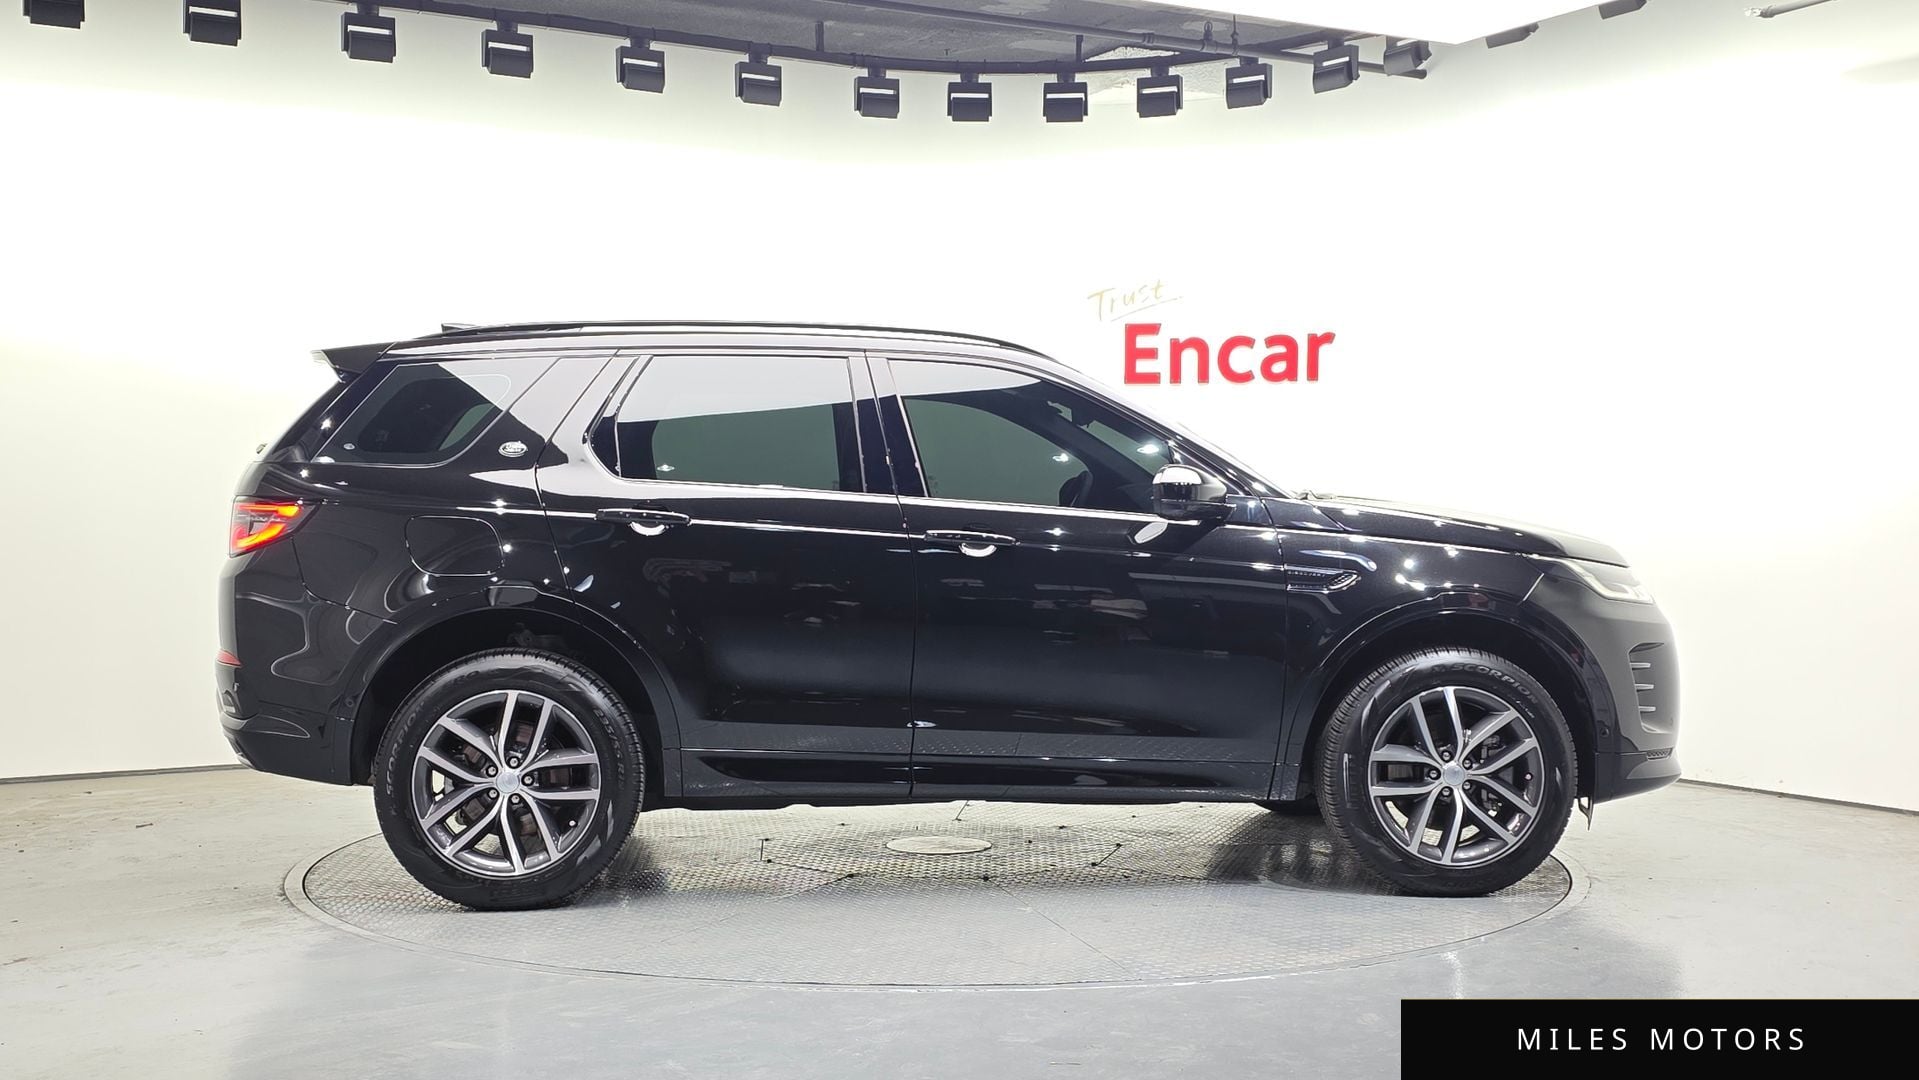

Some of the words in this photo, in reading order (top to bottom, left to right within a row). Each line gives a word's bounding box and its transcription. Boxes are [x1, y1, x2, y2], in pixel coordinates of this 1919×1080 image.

[1087, 279, 1164, 321] Trust
[1123, 322, 1337, 385] Encar
[1450, 662, 1539, 704] SCORPION
